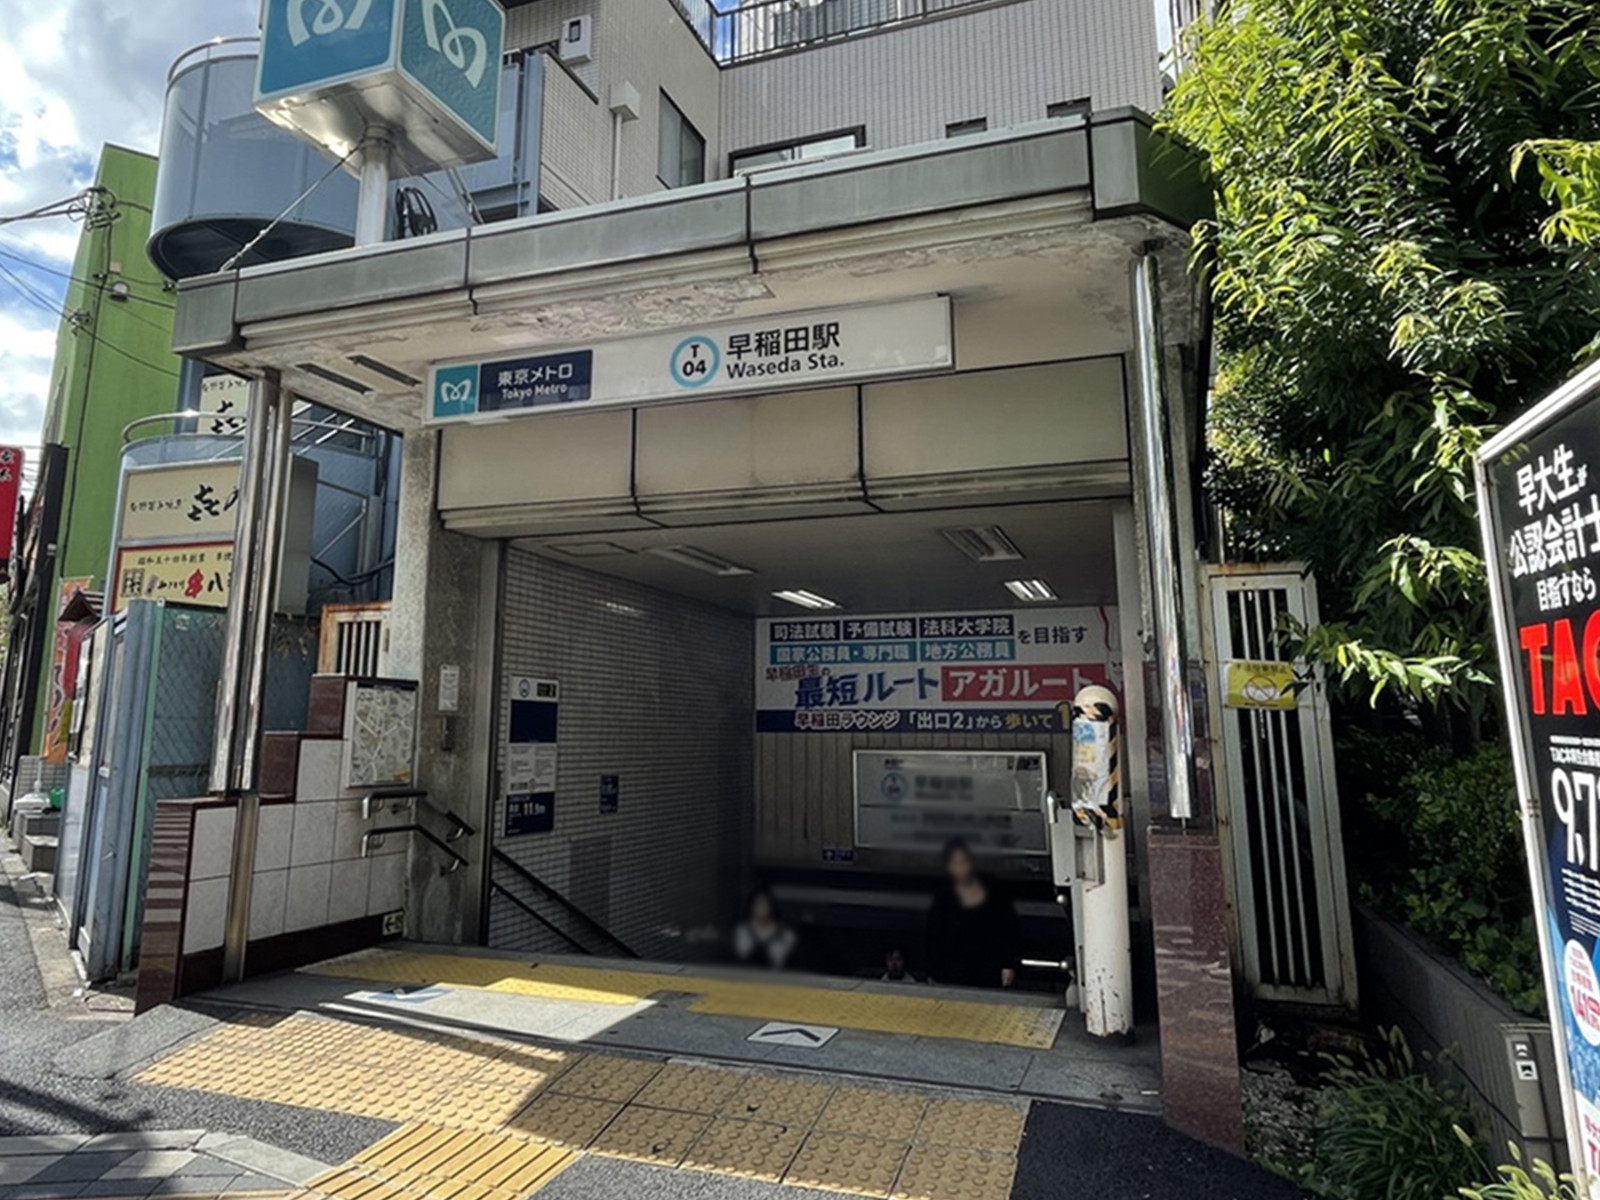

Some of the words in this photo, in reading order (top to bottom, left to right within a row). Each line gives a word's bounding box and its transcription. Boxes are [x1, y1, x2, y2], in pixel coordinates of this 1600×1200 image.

[690, 344, 700, 358] T
[726, 321, 840, 361] 早稲田駅
[498, 363, 573, 387] 東京メトロ
[682, 360, 707, 377] 04
[726, 356, 801, 379] Waseda
[807, 352, 845, 371] Sta.
[502, 387, 533, 401] Tokyo
[534, 383, 568, 397] Metro
[773, 622, 836, 641] 司法試験
[847, 620, 912, 638] 予備試験
[923, 615, 1011, 636] 法科大学院
[1017, 625, 1088, 645] を目指す
[925, 641, 1010, 660] 地方公務員
[794, 666, 939, 709] 最短ルート
[949, 667, 1093, 698] アガルート
